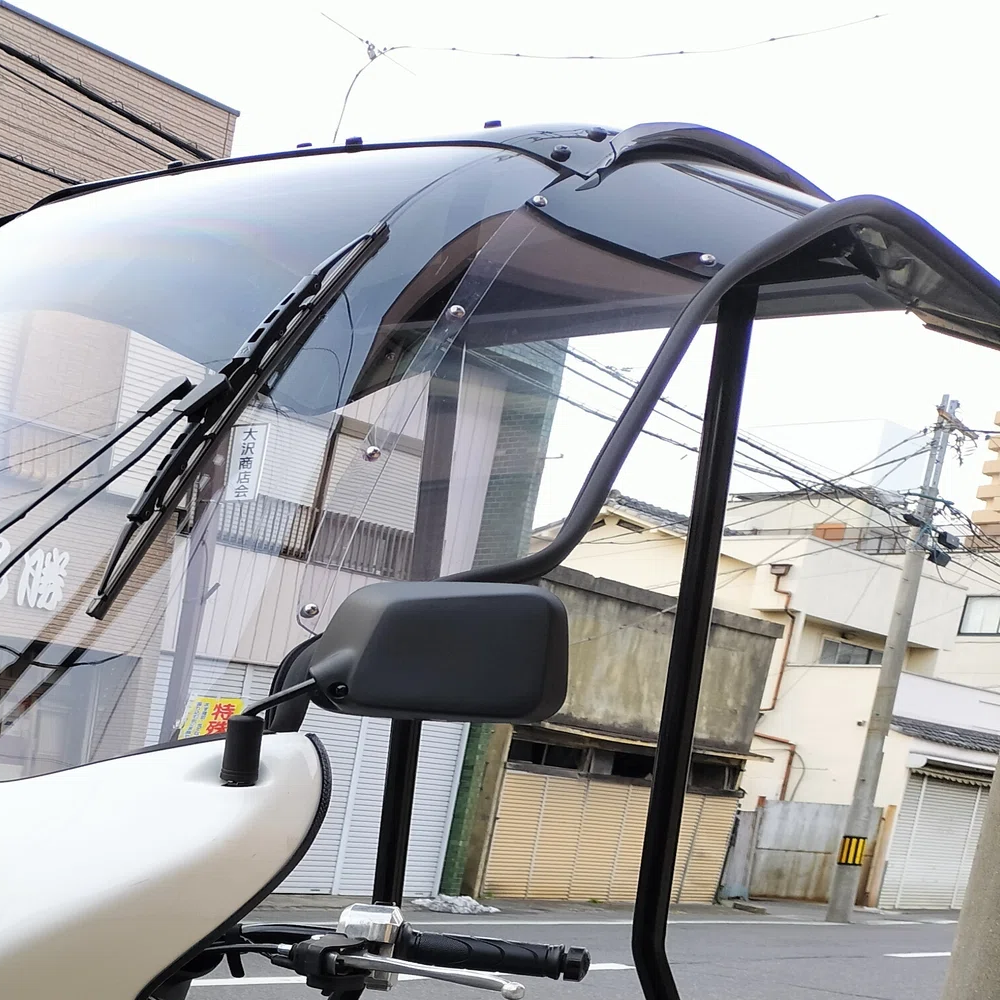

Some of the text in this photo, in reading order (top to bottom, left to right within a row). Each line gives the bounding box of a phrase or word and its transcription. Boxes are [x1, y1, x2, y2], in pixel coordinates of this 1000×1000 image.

[234, 428, 258, 498] 大沢商店会
